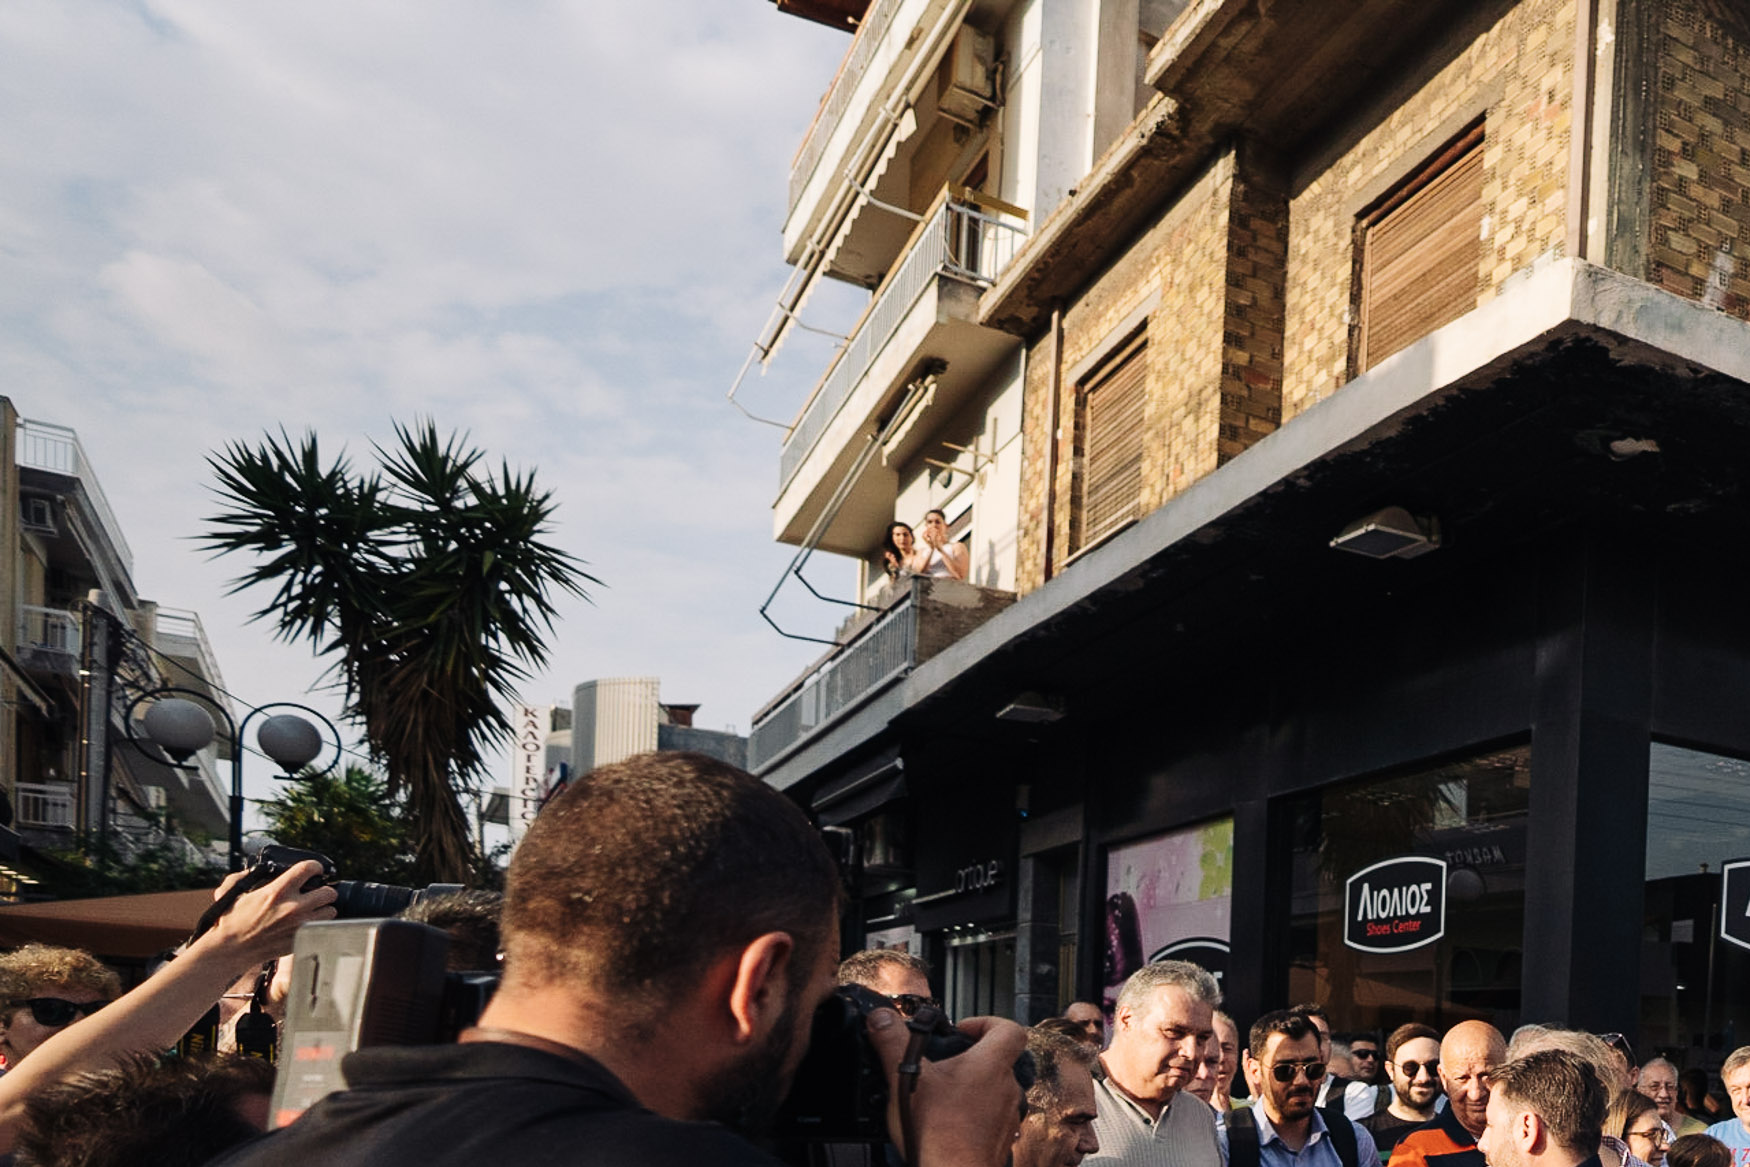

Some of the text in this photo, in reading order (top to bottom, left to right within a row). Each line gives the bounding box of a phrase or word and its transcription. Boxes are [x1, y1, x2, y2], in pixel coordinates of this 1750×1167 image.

[1357, 882, 1433, 922] ΛΙΟΛΙΟΣ
[1366, 919, 1422, 936] Shoes Center
